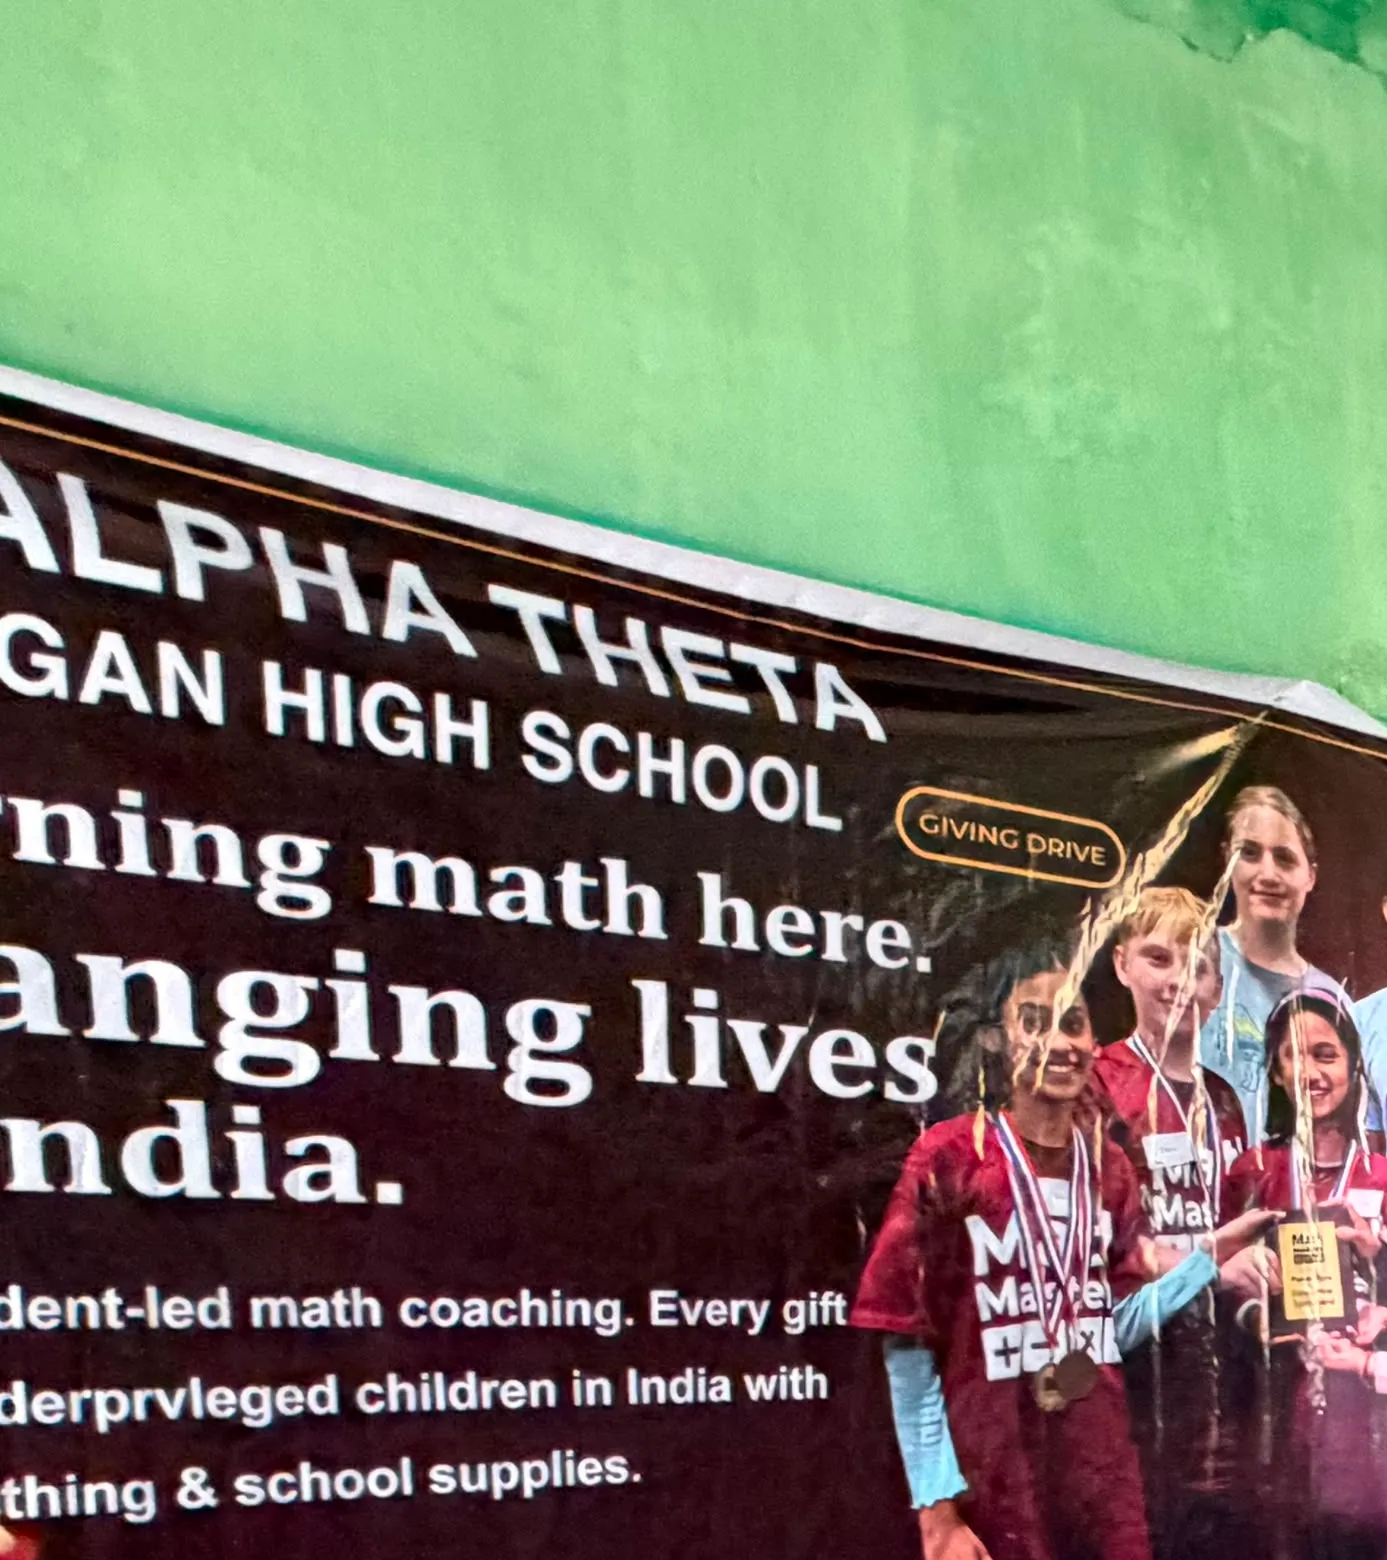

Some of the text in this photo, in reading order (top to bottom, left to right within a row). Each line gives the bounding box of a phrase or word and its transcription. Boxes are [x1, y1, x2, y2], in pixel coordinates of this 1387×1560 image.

[0, 456, 887, 744] ALPHA THETA
[0, 612, 843, 832] GAN HIGH SCHOOL
[0, 788, 933, 974] ning math here.
[918, 812, 1107, 867] GIVING DRIVE
[0, 944, 940, 1108] anging lives
[0, 1100, 403, 1205] ndia.
[250, 1287, 383, 1329] math
[399, 1288, 637, 1337] coaching.
[649, 1289, 771, 1336] Every
[782, 1289, 849, 1336] gift
[355, 1372, 557, 1415] children
[572, 1368, 613, 1407] in
[627, 1365, 733, 1406] India
[743, 1364, 829, 1403] with
[0, 1447, 642, 1523] thing & school supplies.
